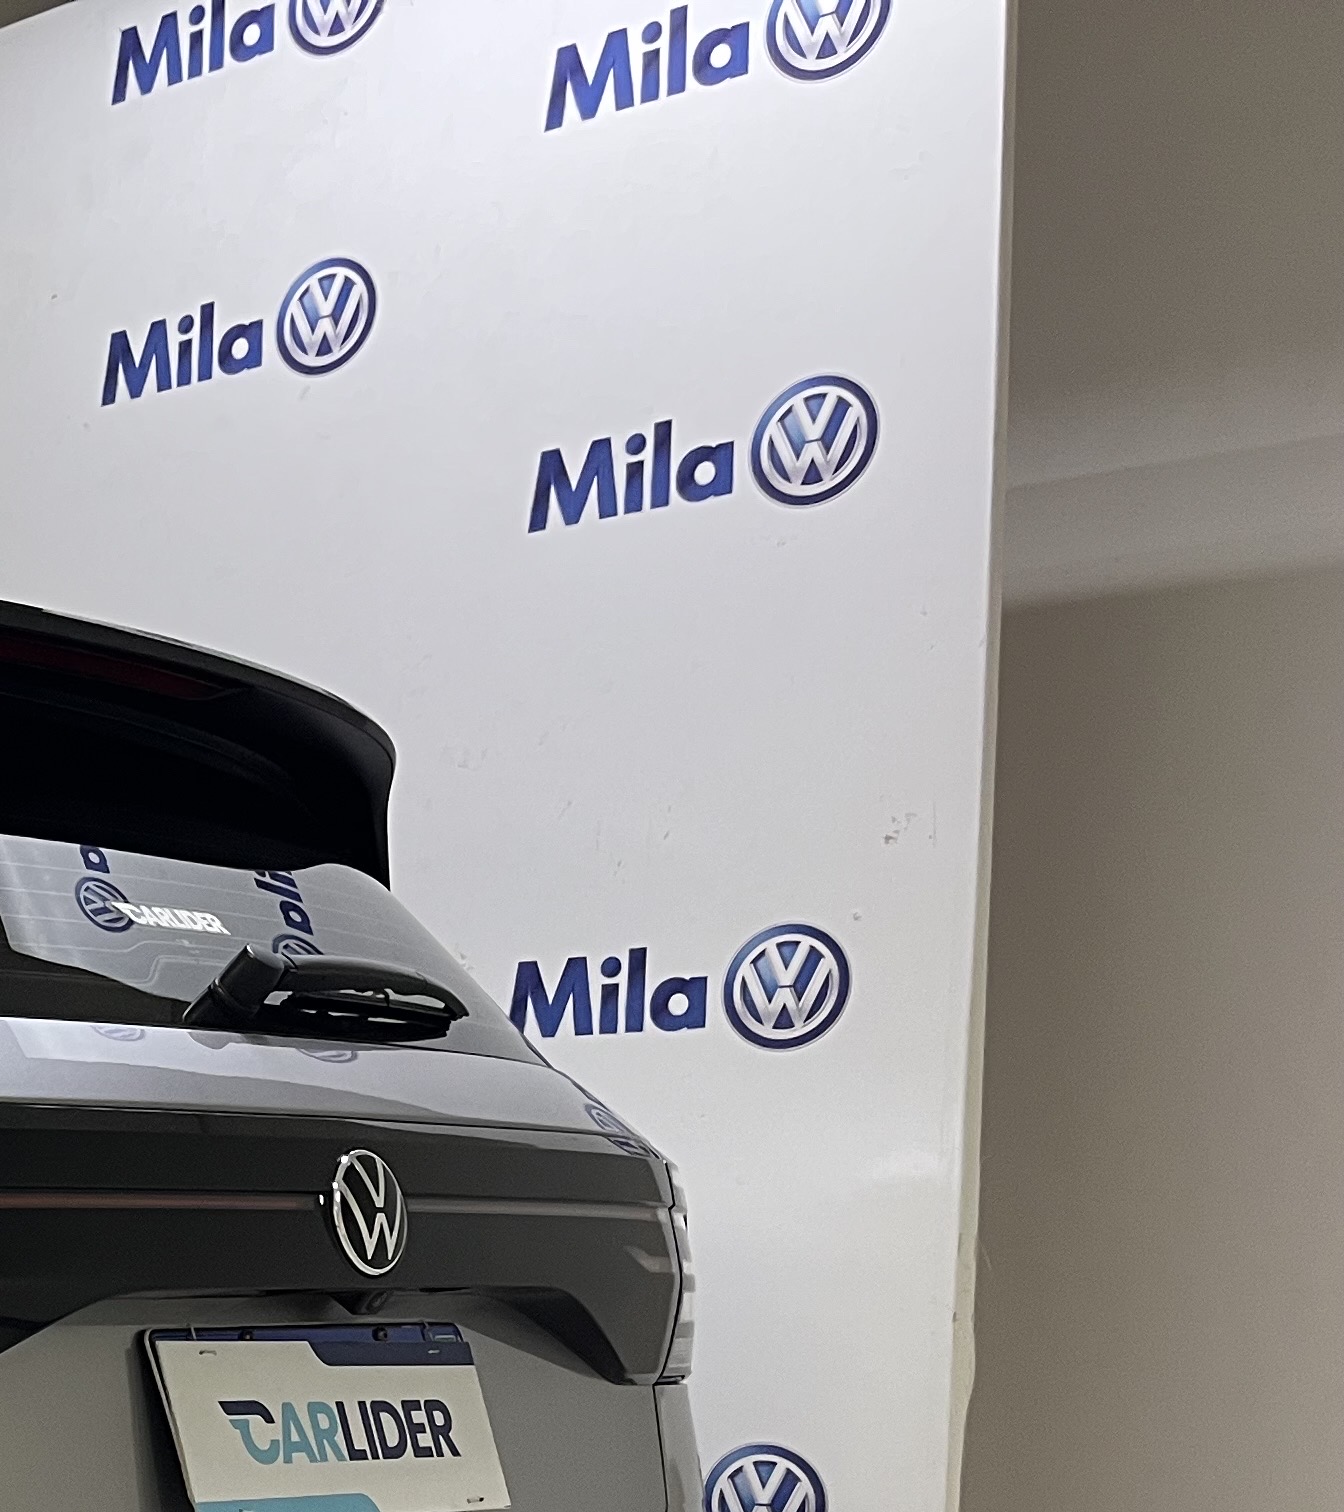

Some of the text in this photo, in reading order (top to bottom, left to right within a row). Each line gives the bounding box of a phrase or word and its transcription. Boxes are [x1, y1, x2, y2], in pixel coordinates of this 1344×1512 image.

[112, 0, 275, 105] Mila
[545, 5, 749, 132] Mila
[102, 302, 263, 406] Mila
[528, 420, 734, 533] Mila
[111, 901, 231, 936] CARLIDER
[509, 947, 708, 1037] Mila
[218, 1399, 462, 1465] CARLIDER
